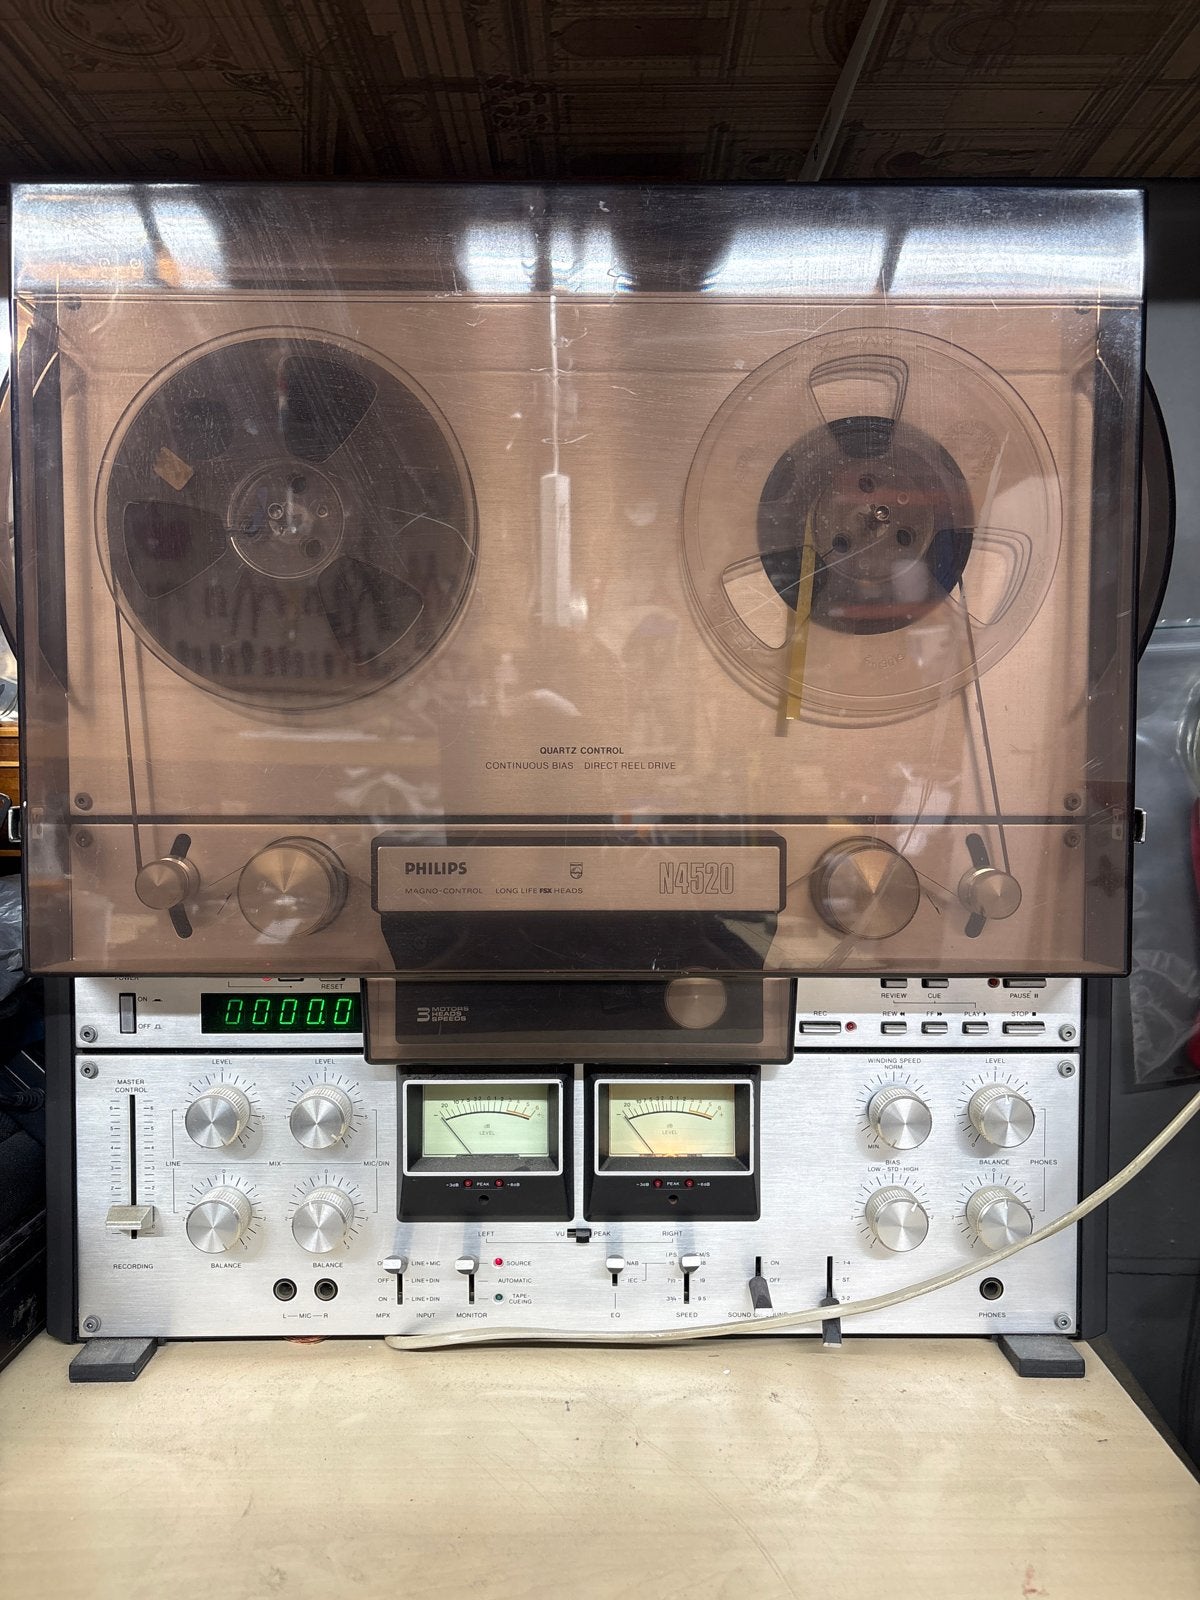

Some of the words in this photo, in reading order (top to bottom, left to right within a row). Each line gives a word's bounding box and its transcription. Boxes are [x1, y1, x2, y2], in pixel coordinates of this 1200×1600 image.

[540, 746, 576, 754] QUARTZ
[580, 746, 624, 754] CONTROL
[486, 762, 549, 770] CONTINUOUS
[552, 762, 574, 770] BIAS
[584, 762, 618, 770] DIRECT
[621, 762, 646, 770] REEL
[648, 762, 676, 770] DRIVE
[404, 861, 468, 875] PHILIPS
[658, 862, 734, 895] N4520
[417, 1007, 430, 1022] 3
